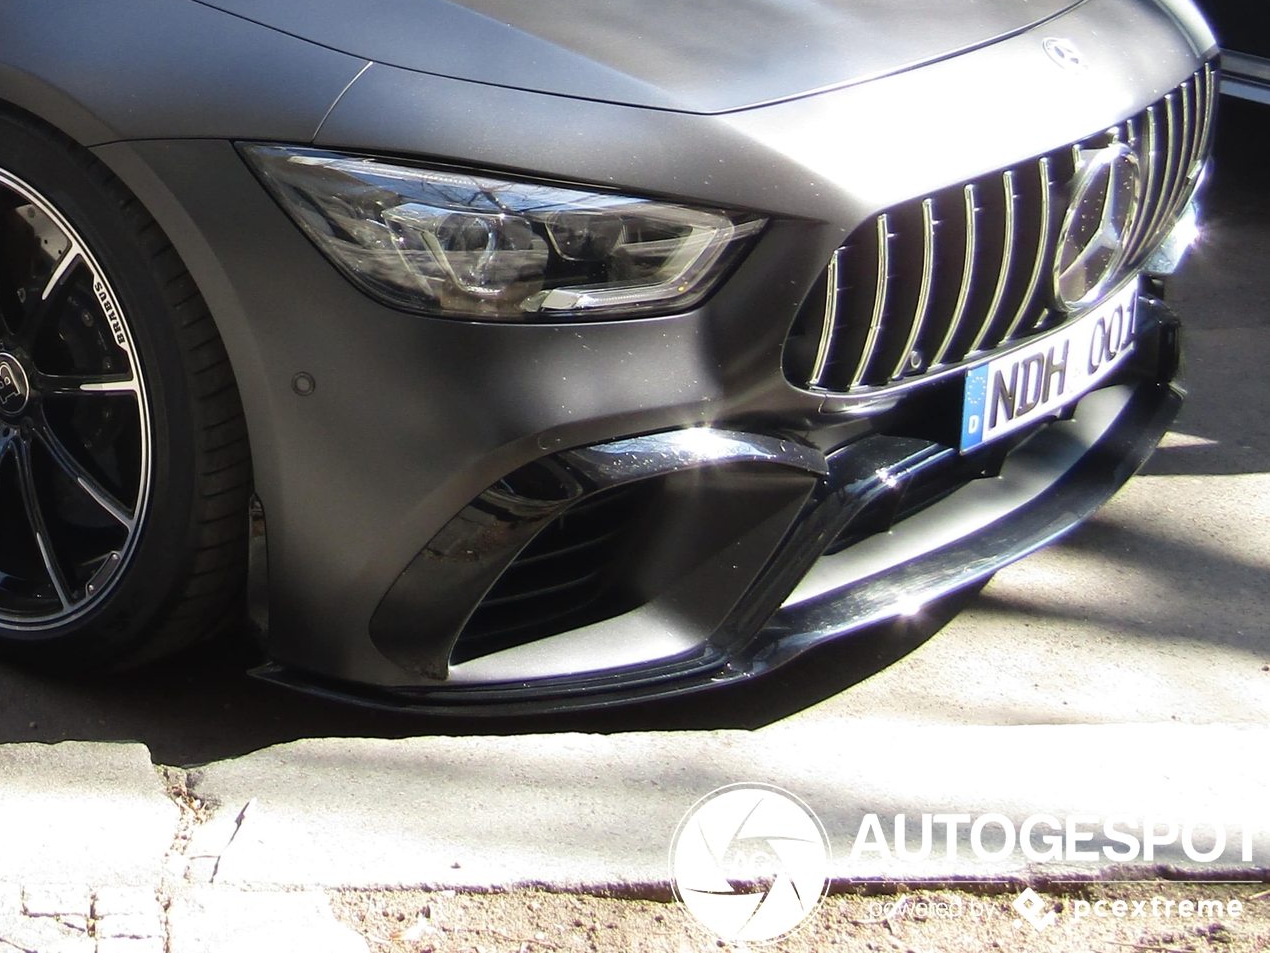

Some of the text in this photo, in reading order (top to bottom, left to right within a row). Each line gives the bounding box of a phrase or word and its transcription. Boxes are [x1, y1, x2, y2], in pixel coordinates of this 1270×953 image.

[94, 281, 126, 345] BRABUS
[988, 339, 1069, 431] NDH
[968, 414, 979, 434] D
